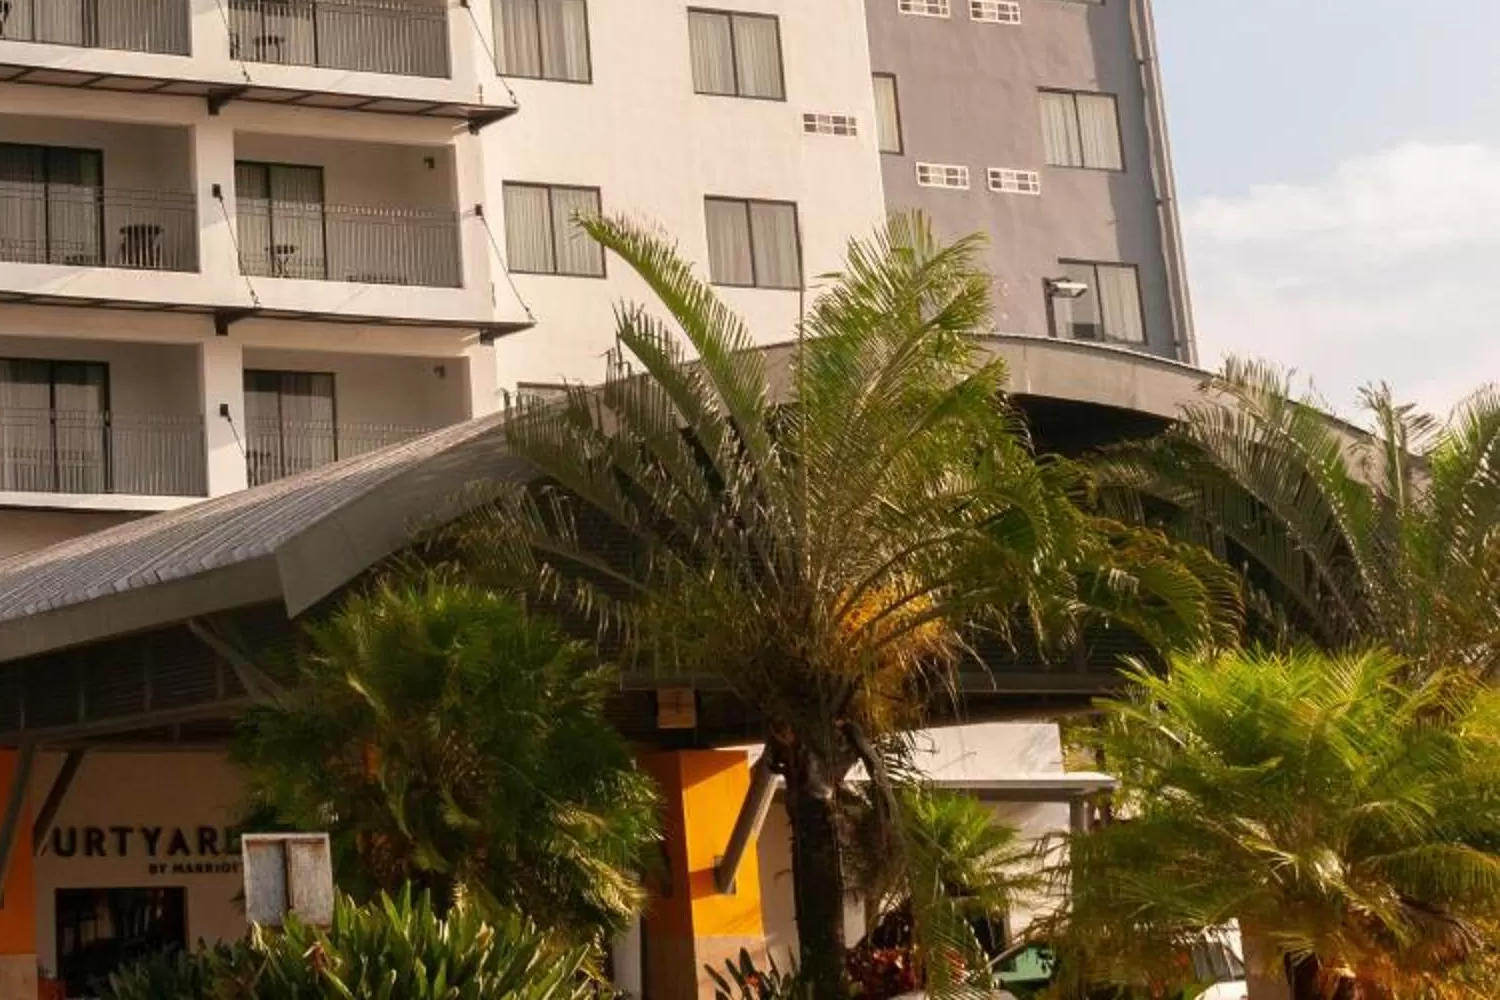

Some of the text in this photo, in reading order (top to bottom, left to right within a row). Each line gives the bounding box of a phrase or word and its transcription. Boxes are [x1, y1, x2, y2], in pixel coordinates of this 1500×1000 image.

[40, 825, 242, 857] URTYARD
[148, 861, 242, 875] BY MARRIOT
